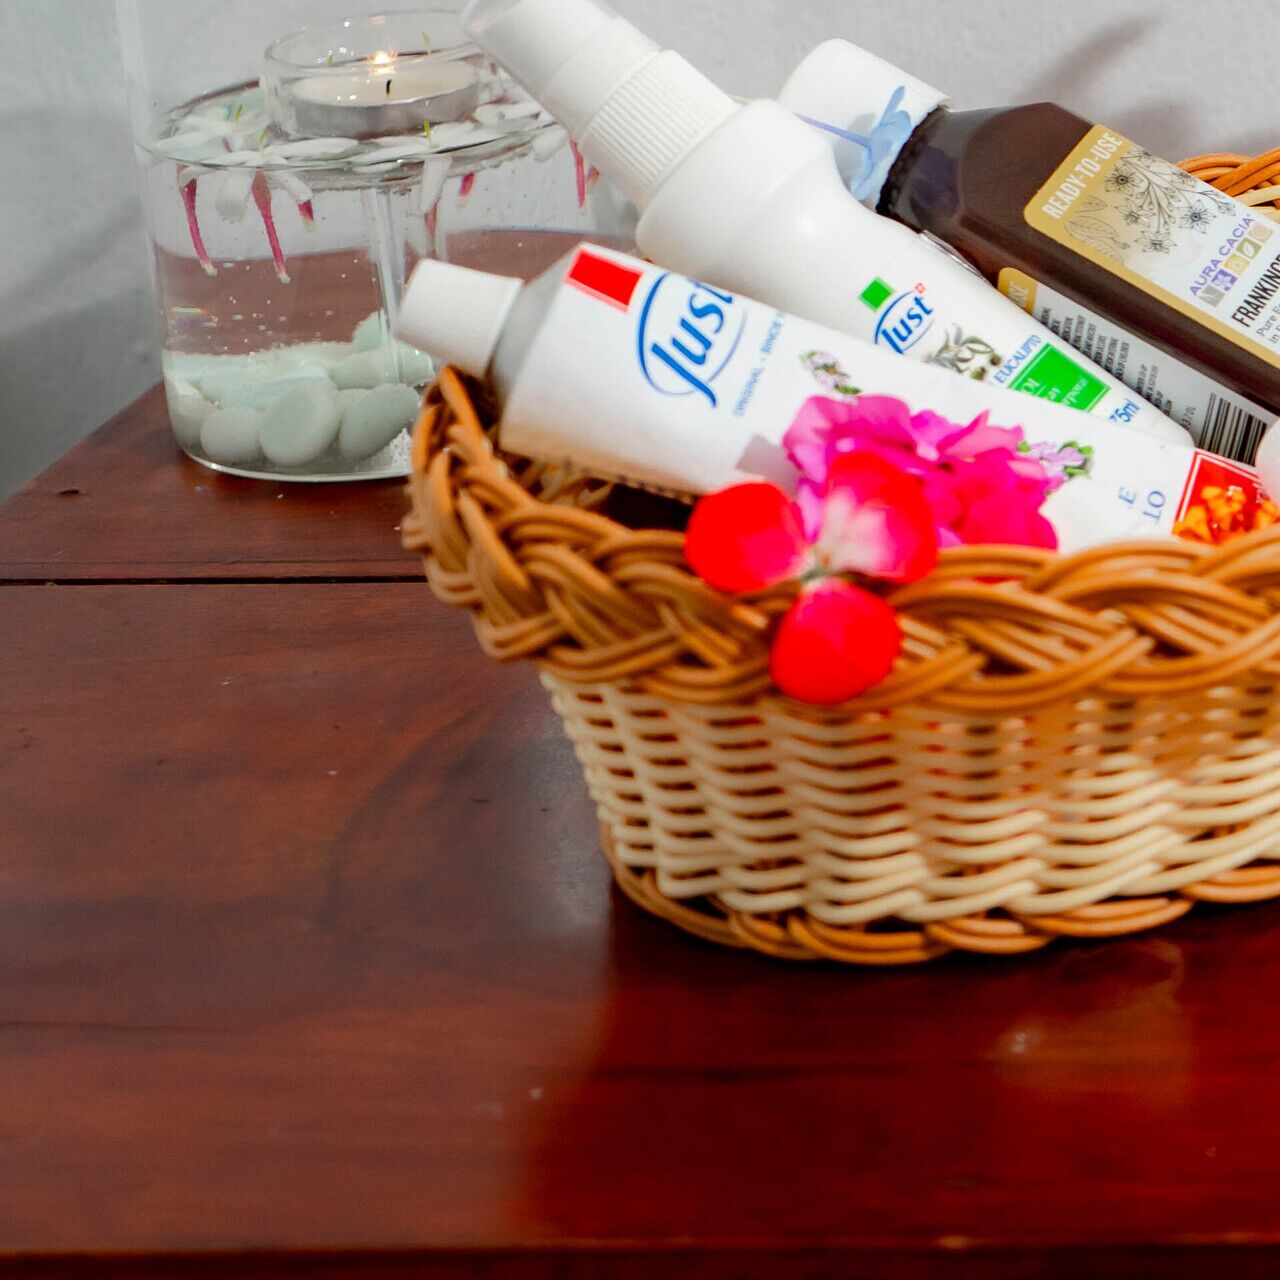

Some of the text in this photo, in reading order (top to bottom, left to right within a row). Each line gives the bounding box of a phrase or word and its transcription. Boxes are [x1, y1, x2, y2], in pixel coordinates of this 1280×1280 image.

[1041, 132, 1123, 219] READY-TO-USE
[1189, 254, 1223, 297] AURA
[1256, 311, 1278, 337] Pure
[1268, 330, 1280, 345] in
